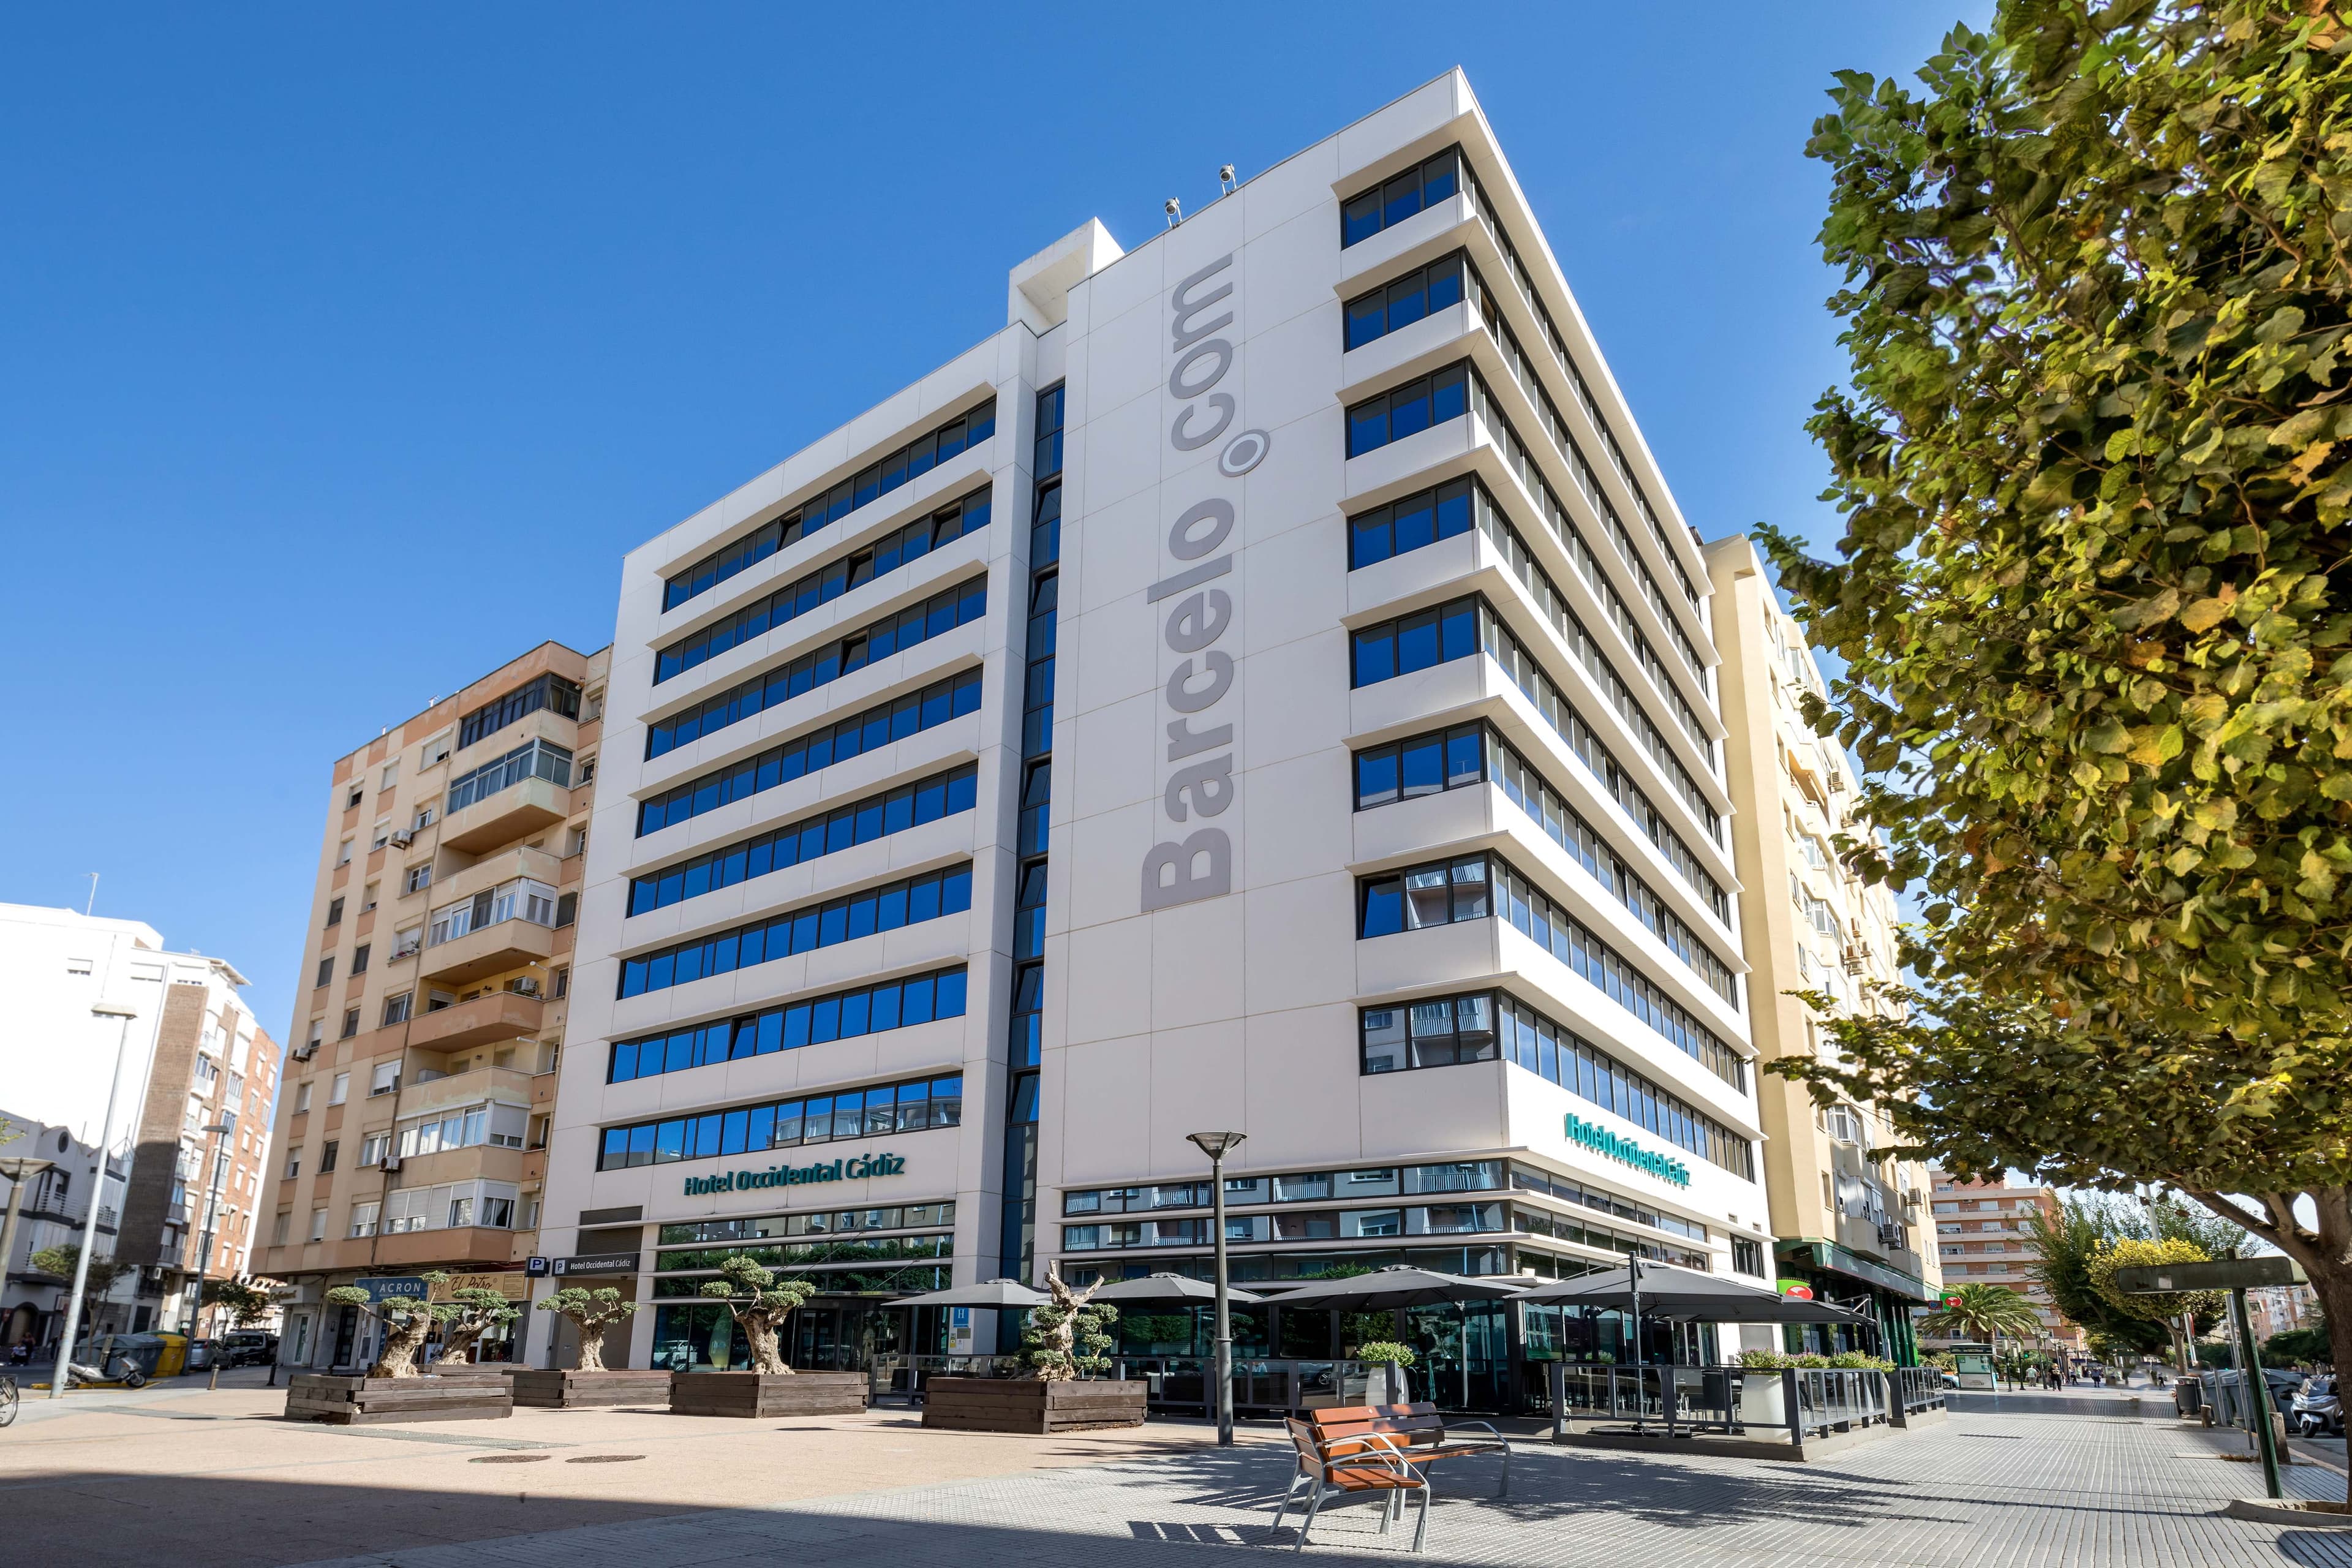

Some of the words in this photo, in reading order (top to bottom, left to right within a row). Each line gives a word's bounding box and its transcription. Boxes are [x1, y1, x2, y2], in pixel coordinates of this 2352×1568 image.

[1564, 1112, 1605, 1152] Hotel
[1604, 1131, 1668, 1177] Occidental
[684, 1171, 733, 1196] Hotel
[736, 1159, 843, 1190] Occidental
[845, 1153, 905, 1179] Cádiz
[532, 1259, 542, 1268] P
[586, 1259, 614, 1269] Occidental
[615, 1259, 631, 1267] Cádiz
[379, 1283, 421, 1293] ACRON
